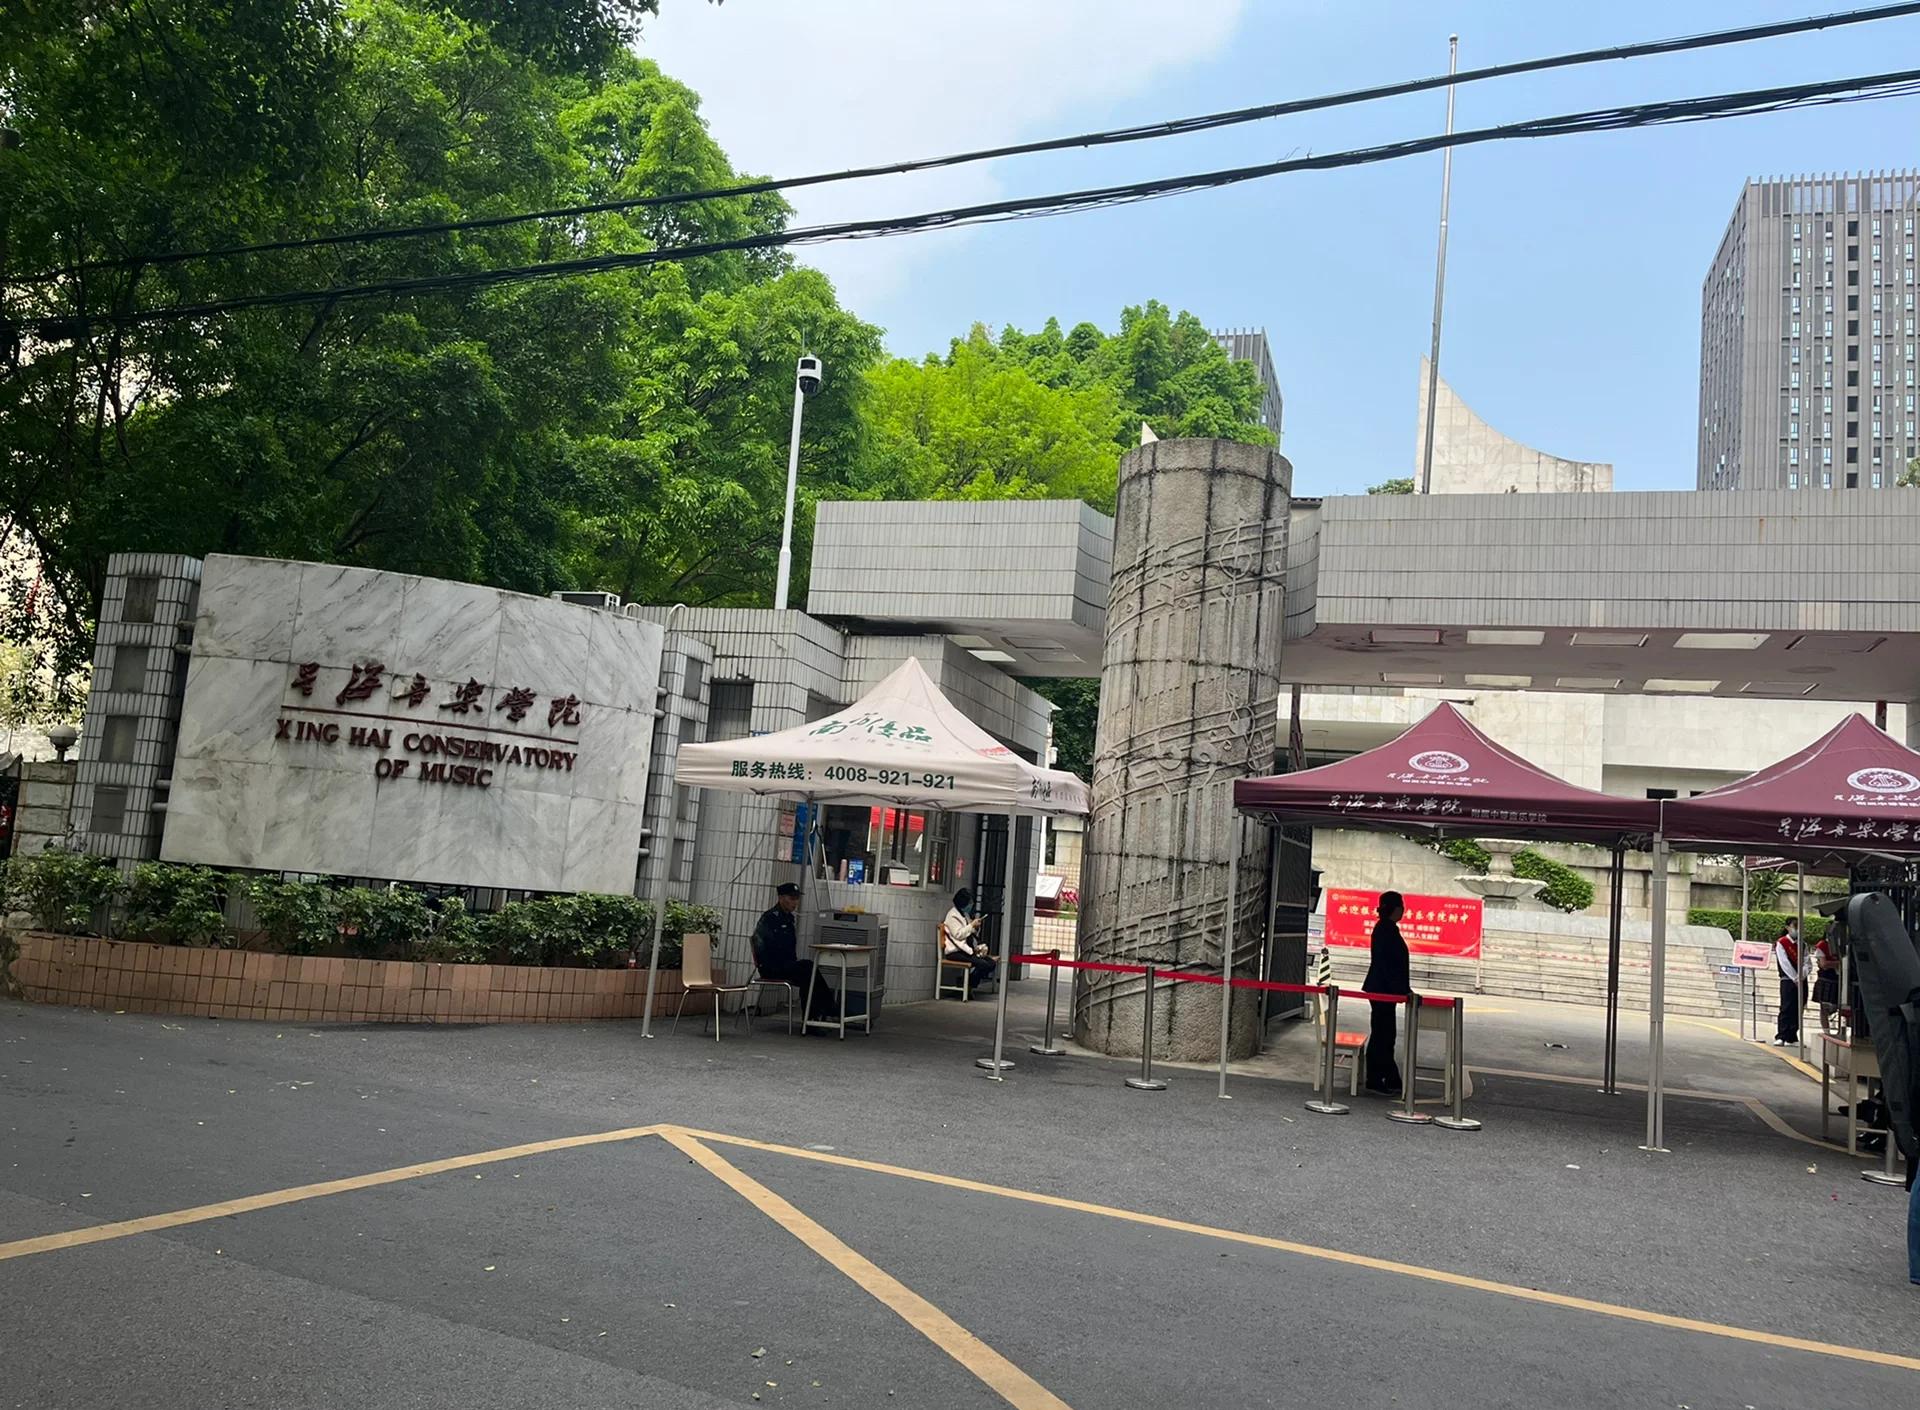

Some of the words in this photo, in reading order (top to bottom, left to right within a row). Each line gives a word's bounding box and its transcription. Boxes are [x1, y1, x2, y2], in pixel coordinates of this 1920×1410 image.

[274, 718, 340, 744] XING
[349, 726, 393, 750] HAI
[403, 732, 579, 772] CONSERVATORY
[375, 757, 410, 779] OF
[418, 760, 494, 788] MUSIC
[824, 765, 956, 790] 4008-921-921
[1338, 904, 1469, 924] 欢迎报音乐学院附中
